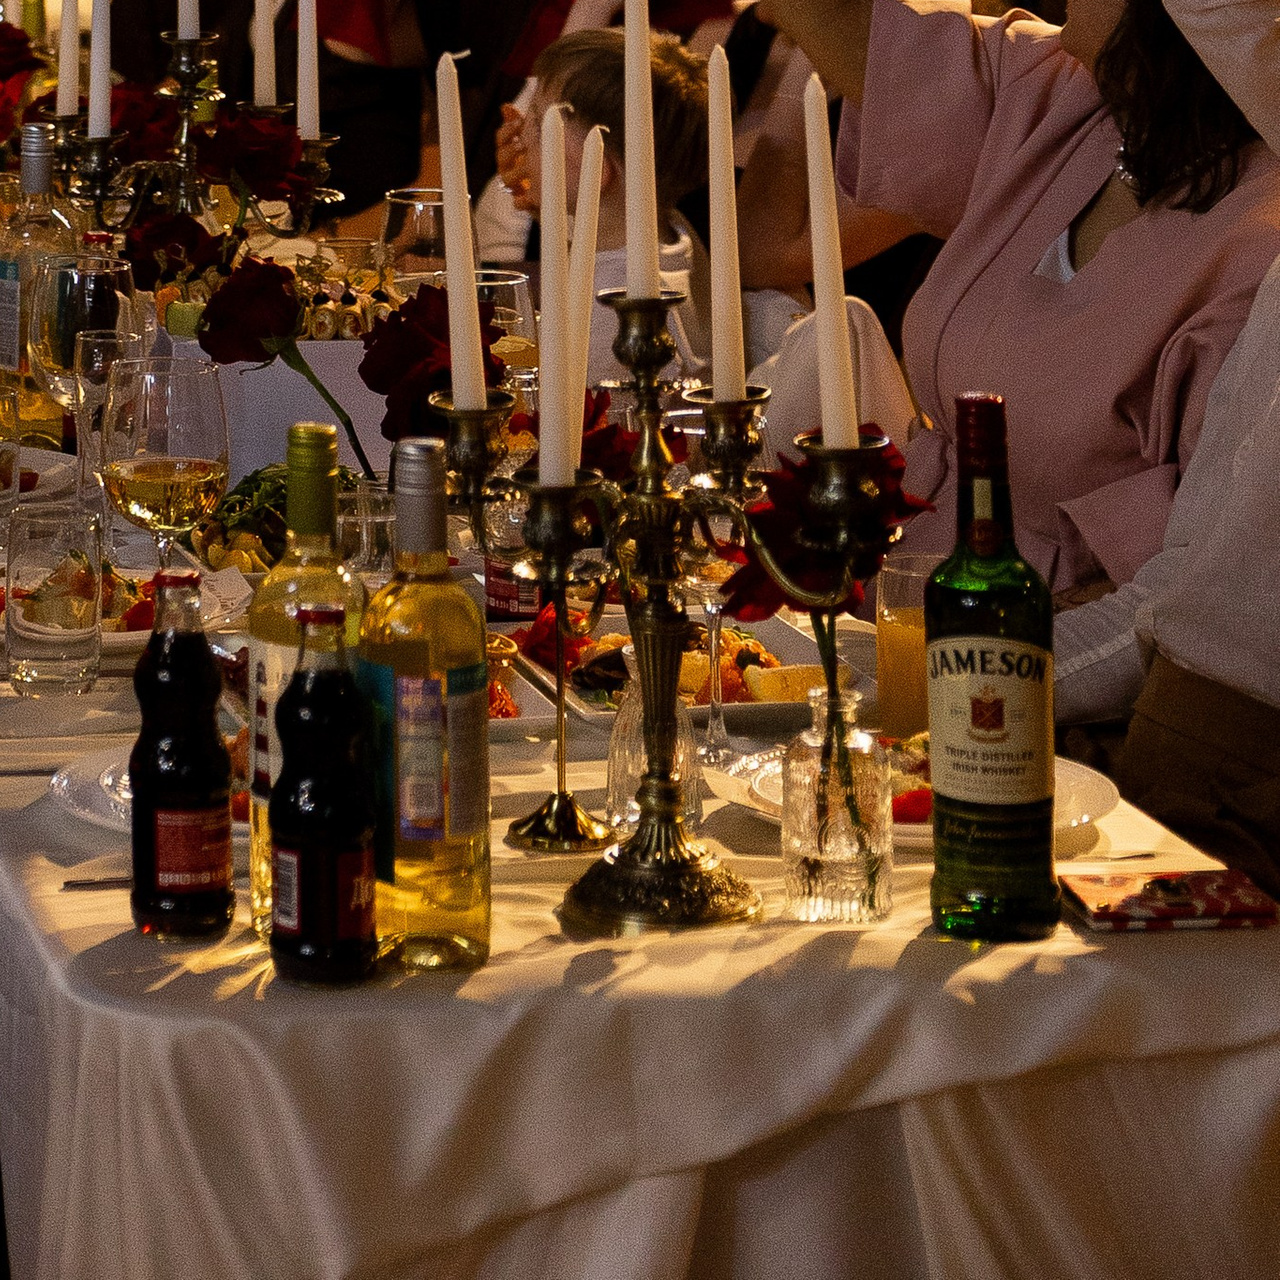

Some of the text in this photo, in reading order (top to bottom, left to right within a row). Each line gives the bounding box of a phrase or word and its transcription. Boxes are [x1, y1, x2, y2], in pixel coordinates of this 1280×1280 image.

[930, 649, 1047, 685] JAMESON
[945, 745, 1035, 763] TRIPLE DISTILLED
[952, 762, 1027, 777] IRISH WHISKEY
